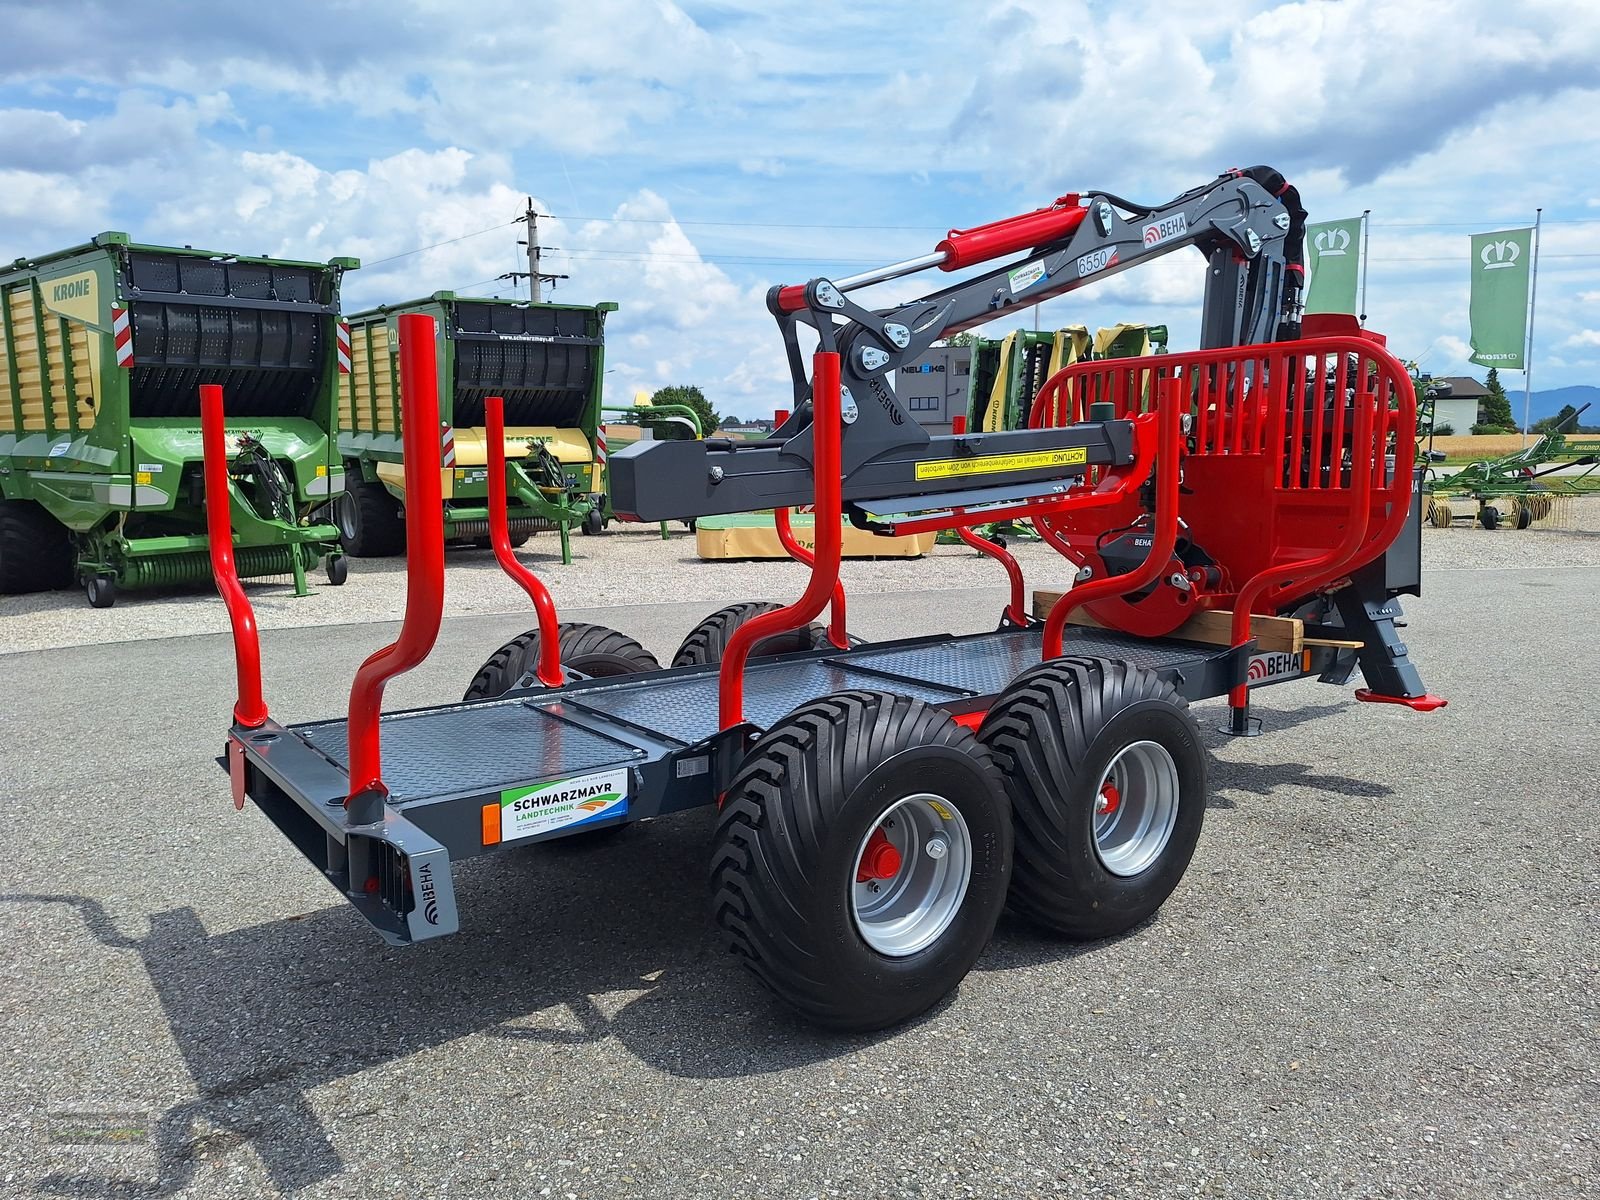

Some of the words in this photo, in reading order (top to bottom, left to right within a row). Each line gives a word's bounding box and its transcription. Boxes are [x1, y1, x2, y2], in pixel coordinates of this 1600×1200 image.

[1160, 216, 1186, 238] BEHA
[1079, 251, 1107, 274] 6550
[54, 278, 90, 302] KRONE
[870, 379, 892, 410] BEHA
[920, 465, 945, 473] verboten
[1052, 452, 1083, 463] ACHTUNG!
[1267, 653, 1300, 676] BEHA
[513, 782, 612, 811] SCHWARZMAYR
[516, 803, 575, 821] LANDTECHNIK
[419, 862, 436, 901] BEHA
